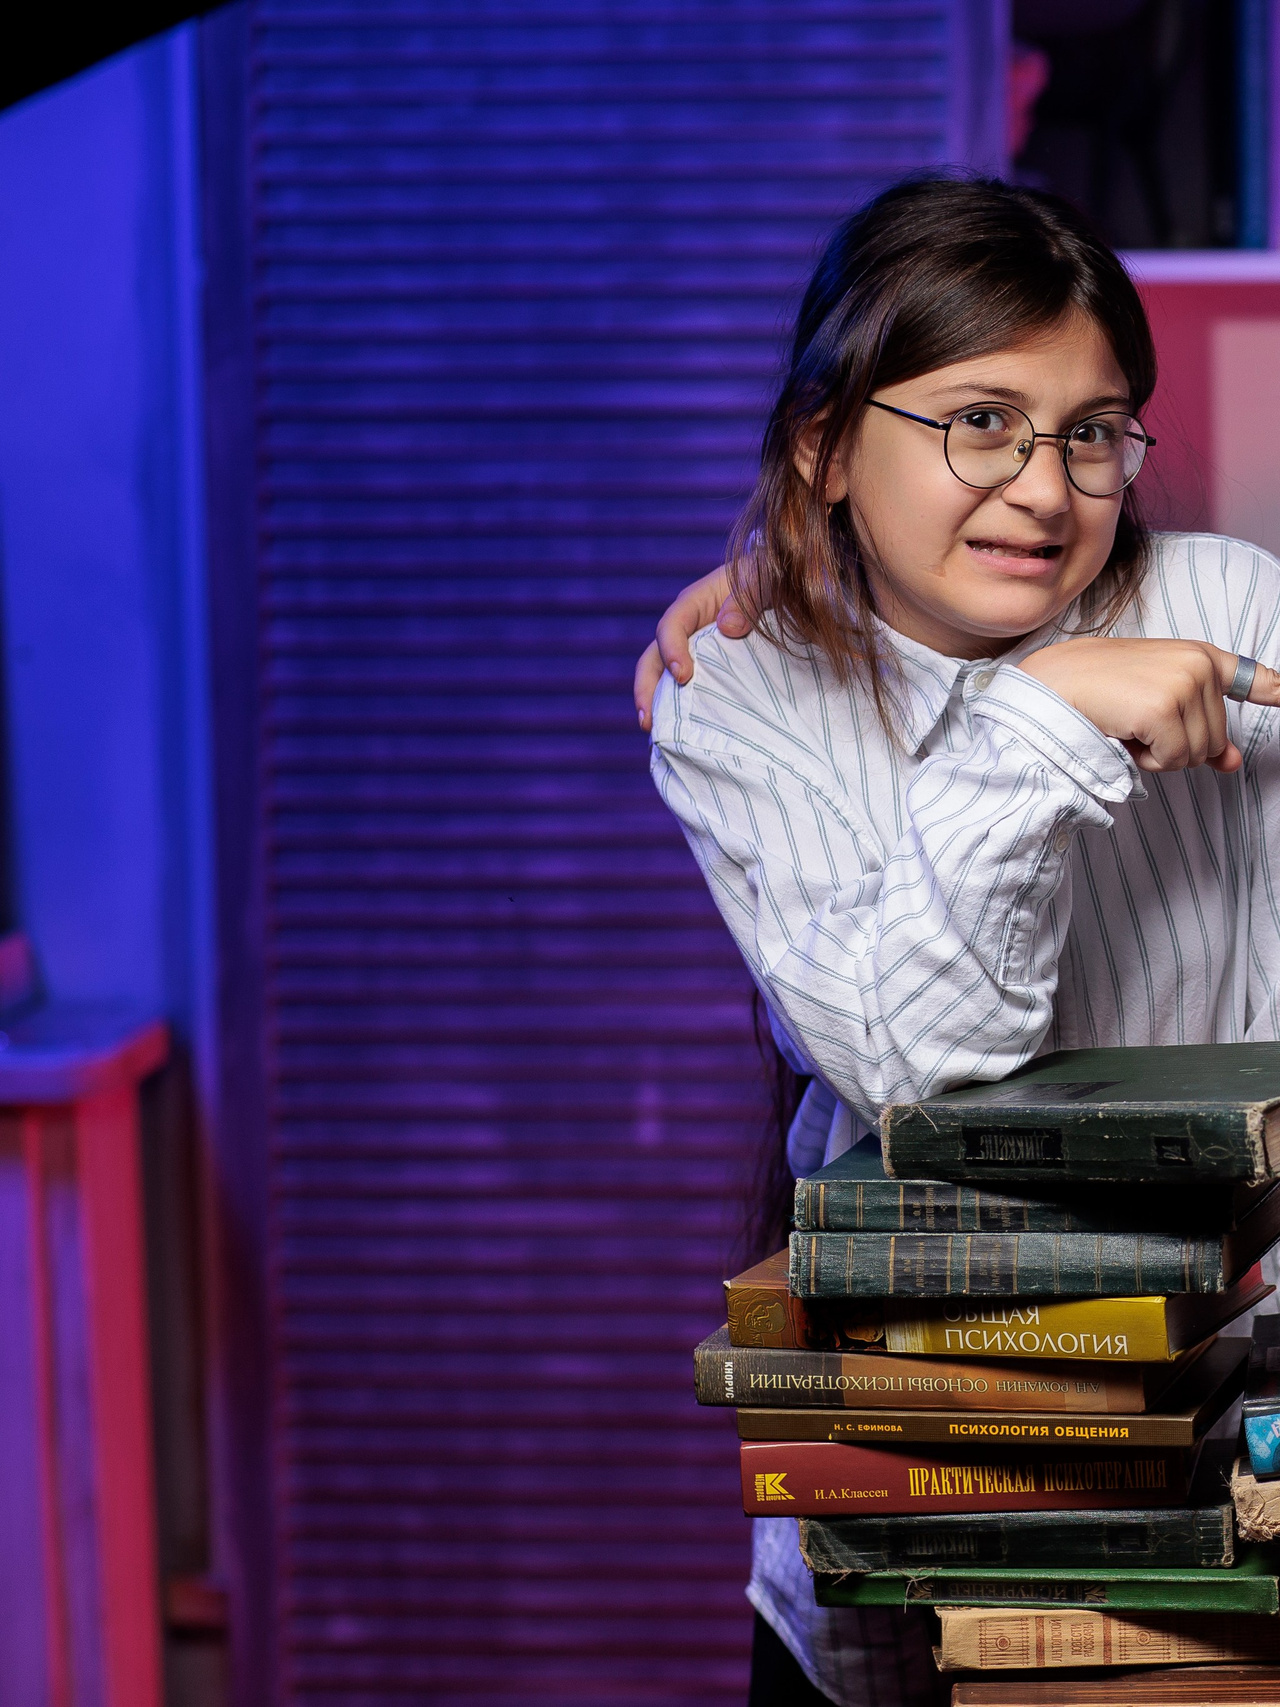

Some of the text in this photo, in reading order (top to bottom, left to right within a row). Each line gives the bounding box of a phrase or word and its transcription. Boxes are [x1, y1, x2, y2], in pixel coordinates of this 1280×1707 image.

[943, 1301, 1041, 1328] ОБЩАЯ
[945, 1329, 1129, 1355] ПСИХОЛОГИЯ
[724, 1361, 735, 1399] КНОРУС
[750, 1373, 902, 1391] ПСИХОТЕРАПИИ
[907, 1377, 988, 1393] ОСНОВЫ
[996, 1380, 1069, 1393] РОМАНИН
[834, 1423, 1129, 1439] Н. С. ЕФИМОВА ПСИХОЛОГИЯ ОБЩЕНИЯ
[908, 1459, 1168, 1497] ПРАКТИЧЕСКАЯ ПСИХОТЕРАПИЯ
[814, 1488, 888, 1500] И.А.Классен
[1071, 1623, 1082, 1655] ПОВЕСТИ
[1083, 1622, 1095, 1658] РАССКАЗЫ
